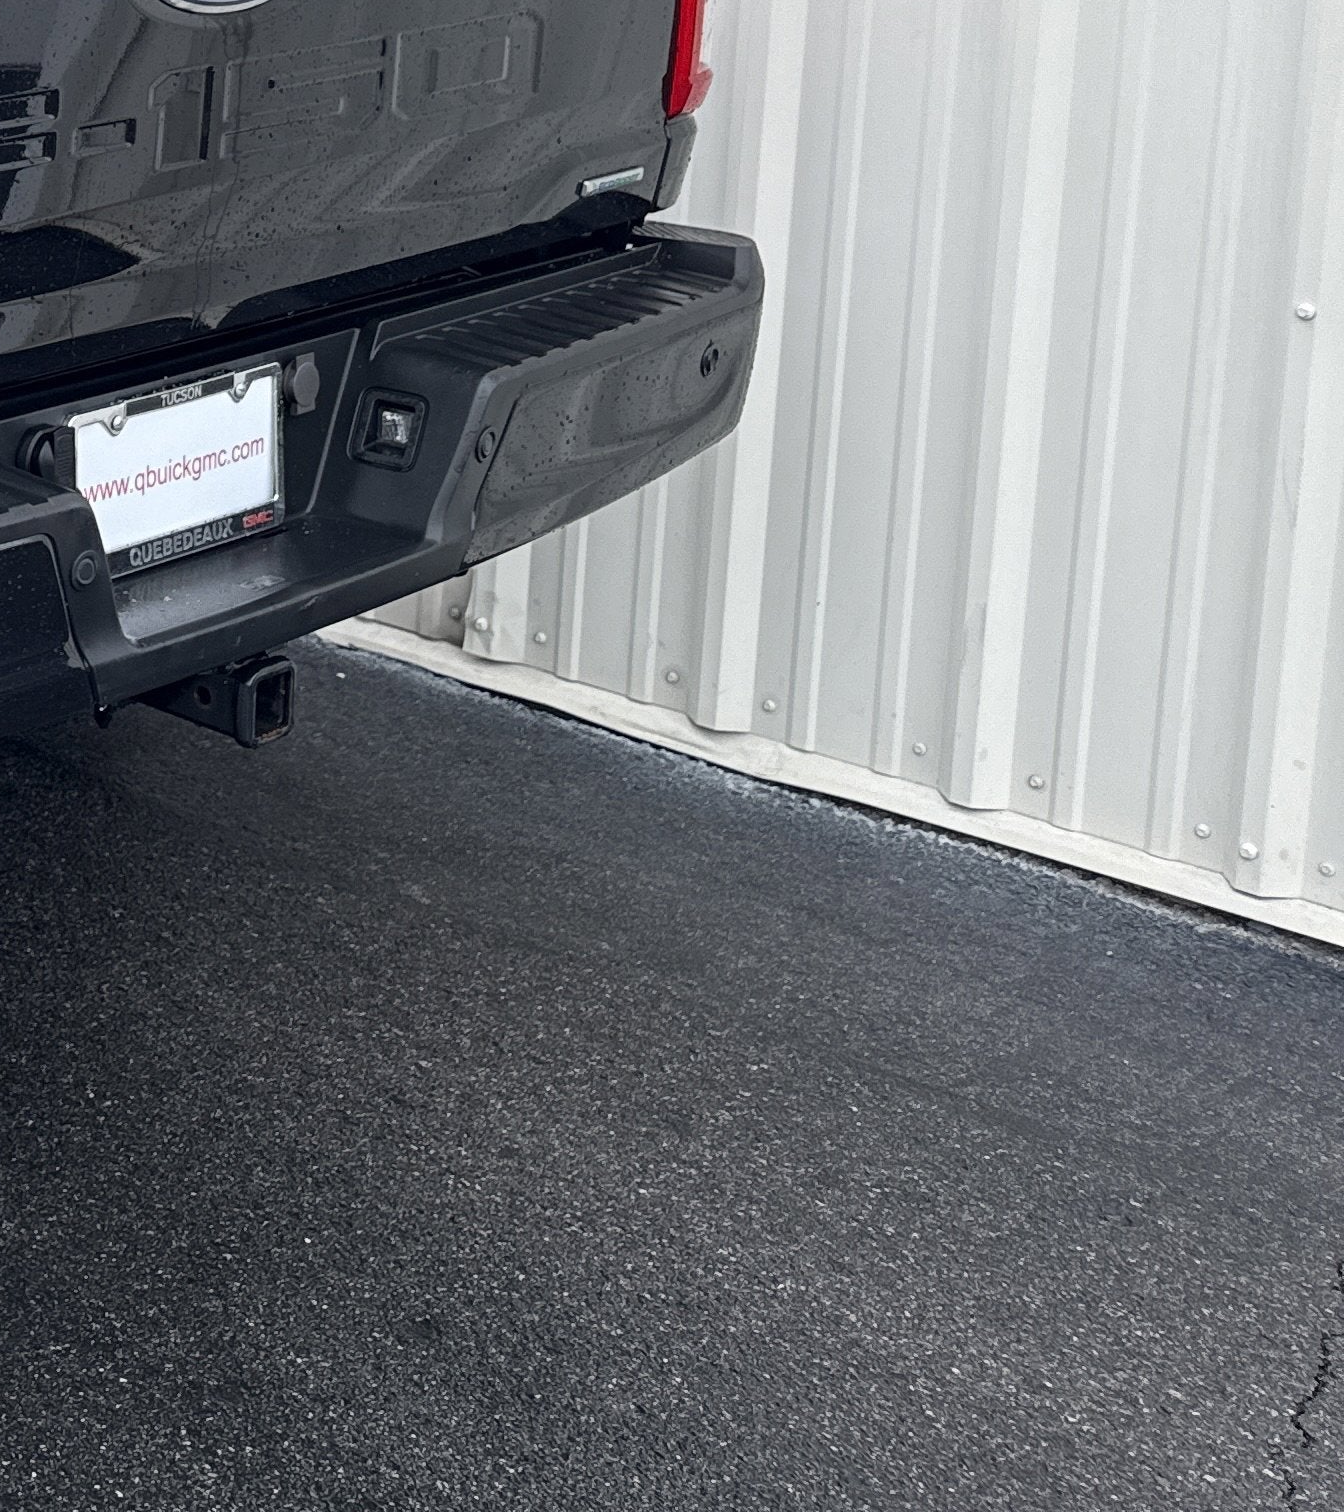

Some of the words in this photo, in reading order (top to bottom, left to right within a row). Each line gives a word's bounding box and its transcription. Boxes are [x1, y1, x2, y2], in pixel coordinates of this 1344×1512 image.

[161, 384, 203, 407] TUCSON
[83, 437, 265, 503] www.qbuickgmc.com
[129, 517, 234, 567] QUEBEDEAUX
[242, 509, 274, 529] GMC
